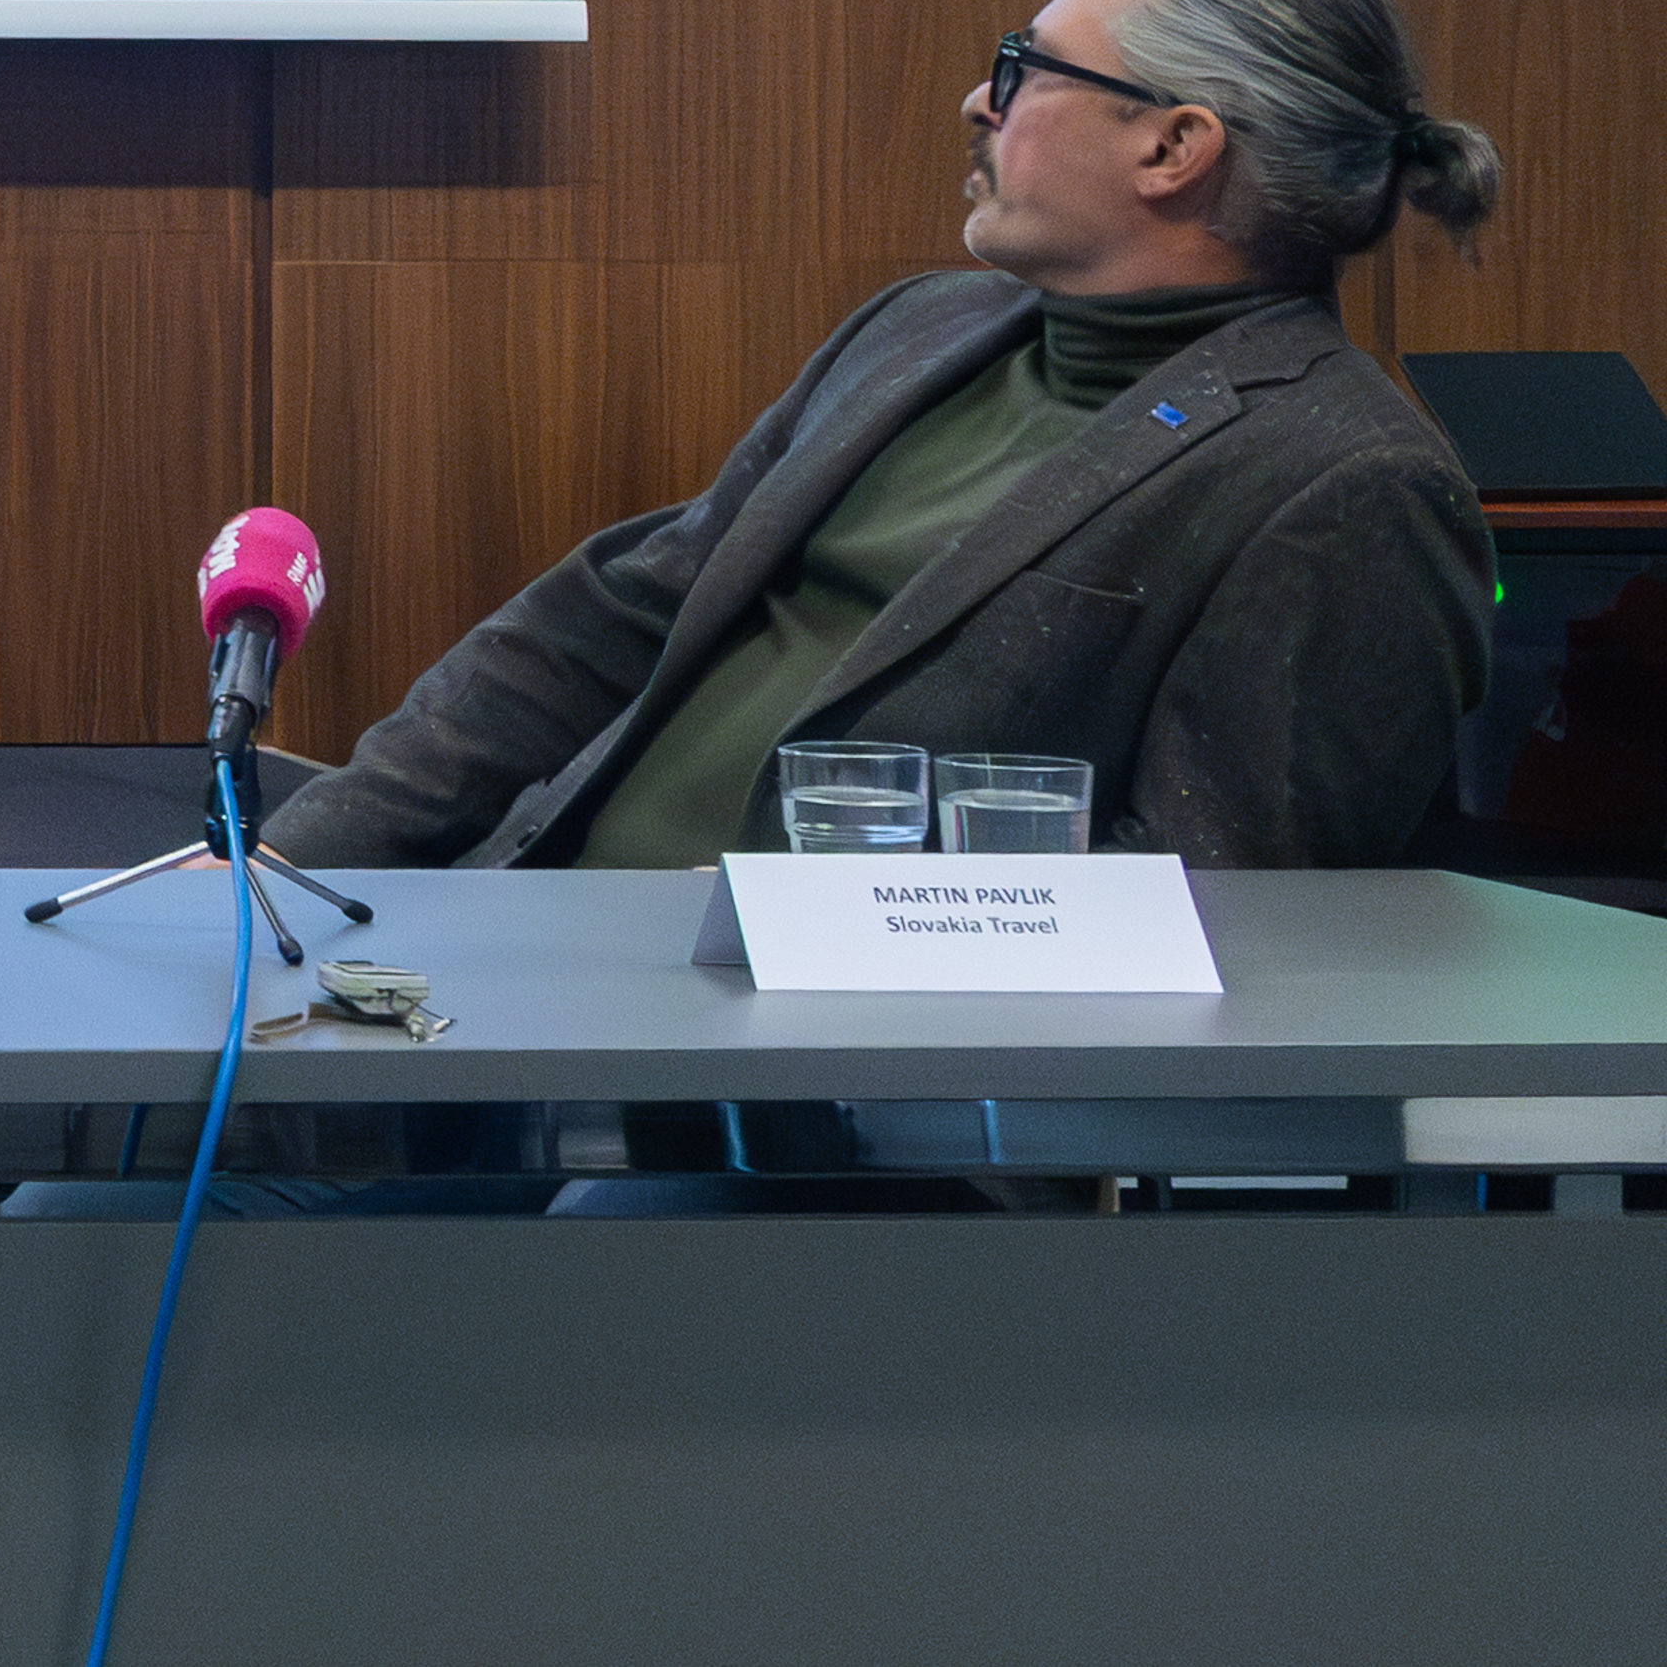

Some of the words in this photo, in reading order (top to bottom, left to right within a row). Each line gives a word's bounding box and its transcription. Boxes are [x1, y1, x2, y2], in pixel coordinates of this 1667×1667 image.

[873, 885, 968, 905] MARTIN
[976, 887, 1057, 906] PAVLIK
[885, 914, 984, 934] Slovakia
[987, 915, 1060, 935] Travel
